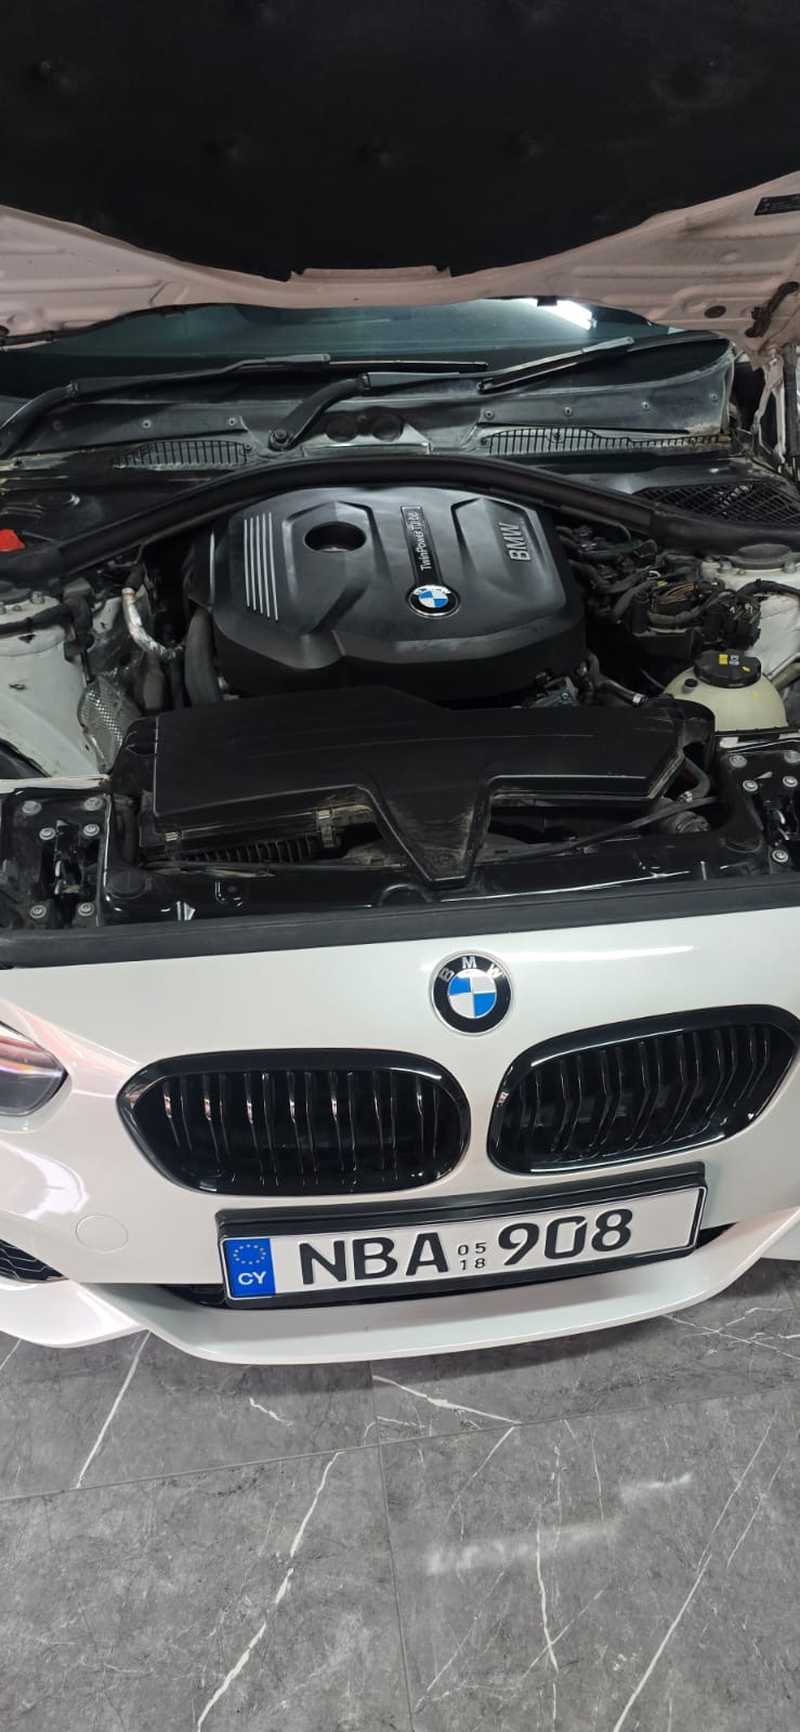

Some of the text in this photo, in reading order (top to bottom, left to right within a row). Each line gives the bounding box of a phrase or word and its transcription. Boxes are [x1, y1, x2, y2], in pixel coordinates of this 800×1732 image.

[499, 522, 531, 562] BMW
[438, 955, 505, 983] BMW
[298, 1208, 633, 1286] NBA 908
[457, 1241, 487, 1256] 05
[459, 1257, 486, 1271] 18
[237, 1270, 267, 1287] CY
